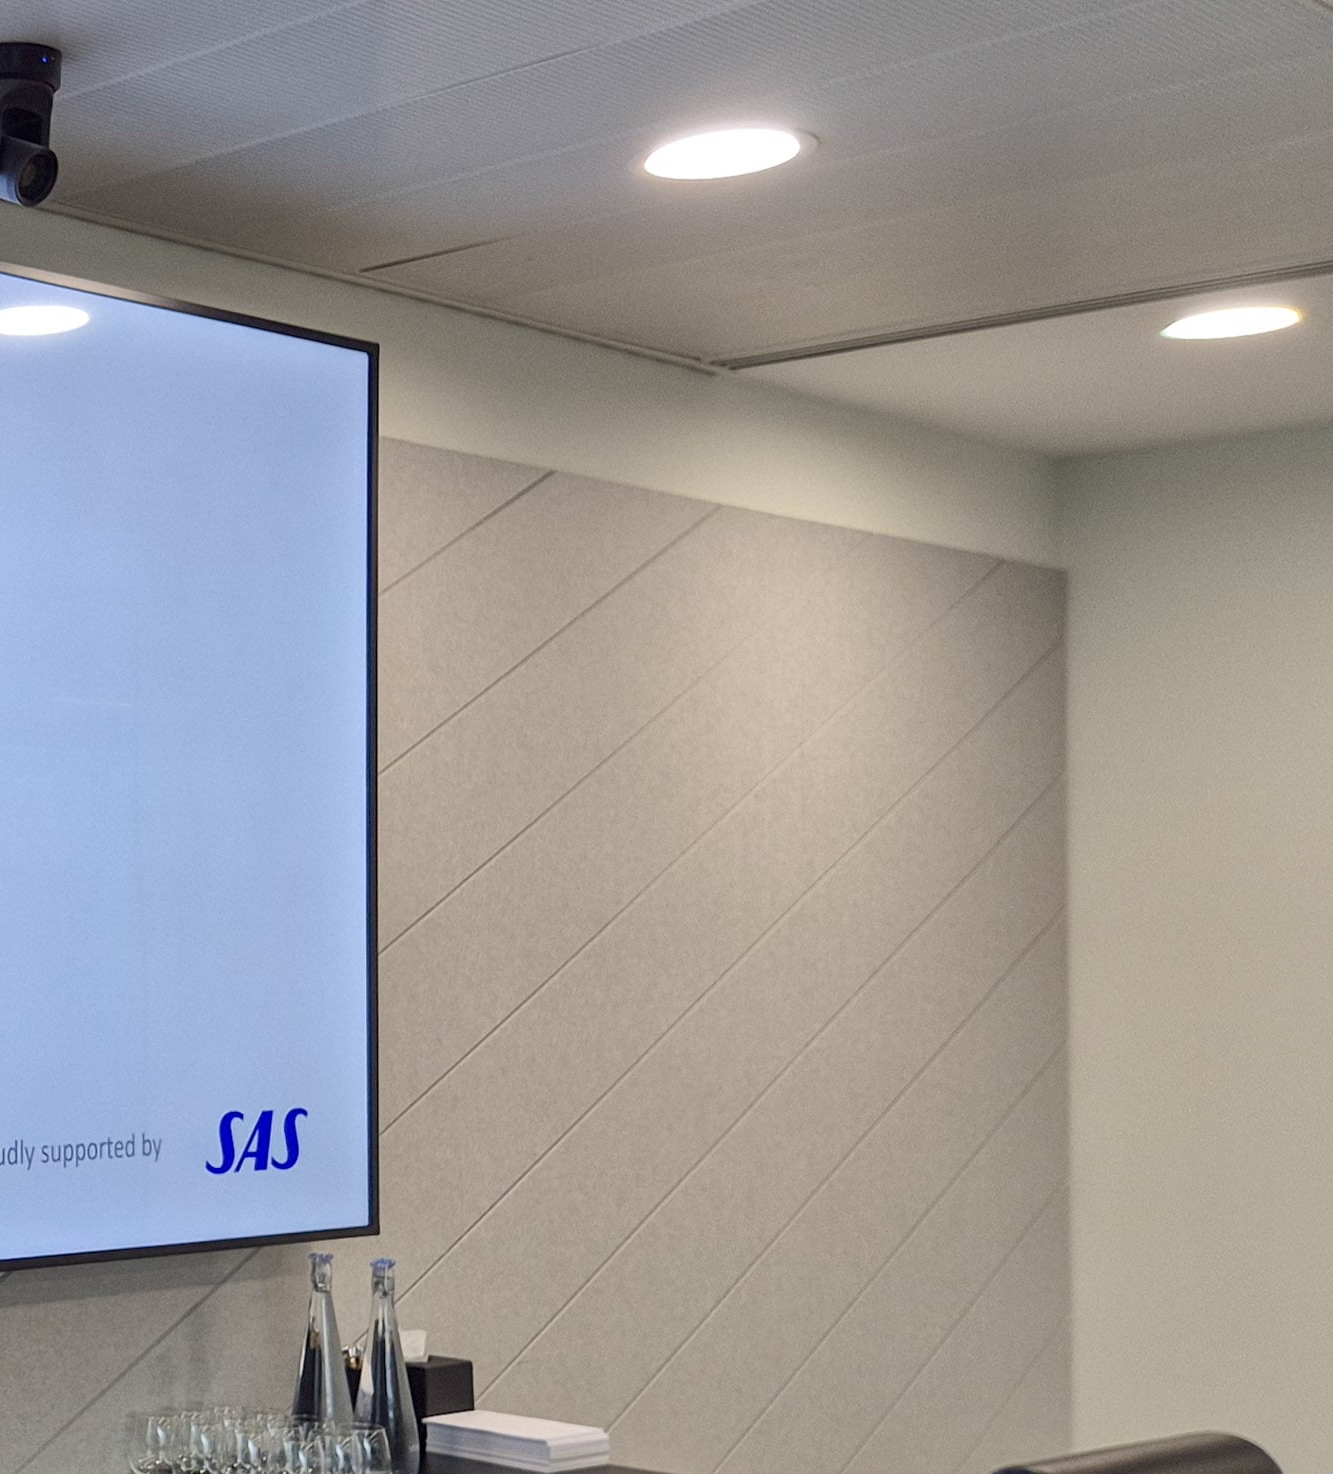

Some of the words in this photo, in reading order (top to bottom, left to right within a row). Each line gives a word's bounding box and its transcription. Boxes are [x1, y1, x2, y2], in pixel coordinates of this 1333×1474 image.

[40, 1133, 136, 1168] supported
[141, 1132, 163, 1162] by
[205, 1107, 309, 1175] SAS
